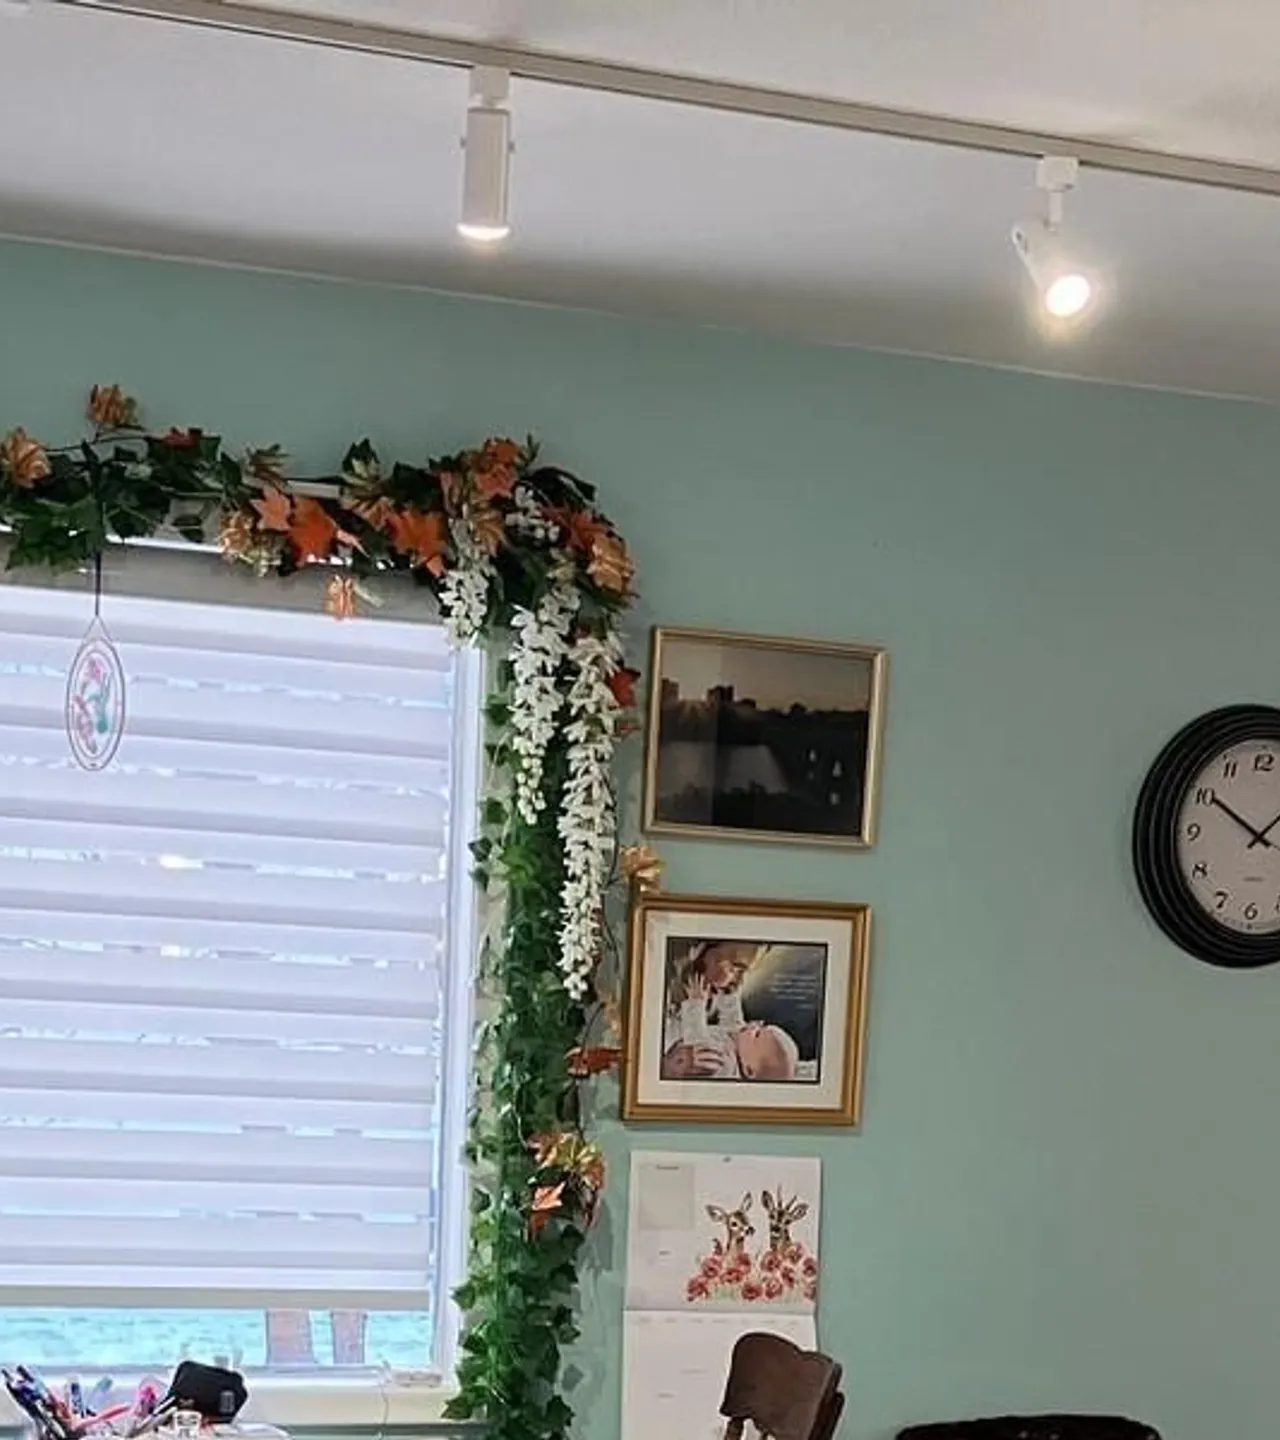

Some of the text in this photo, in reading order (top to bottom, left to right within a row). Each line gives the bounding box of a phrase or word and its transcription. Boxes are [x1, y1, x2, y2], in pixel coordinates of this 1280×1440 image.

[1223, 760, 1238, 779] 11
[1252, 753, 1275, 772] 12
[1195, 787, 1216, 807] 10
[1186, 823, 1201, 841] 9
[1192, 862, 1208, 878] 8
[1215, 891, 1229, 908] 7
[1244, 902, 1258, 920] 6
